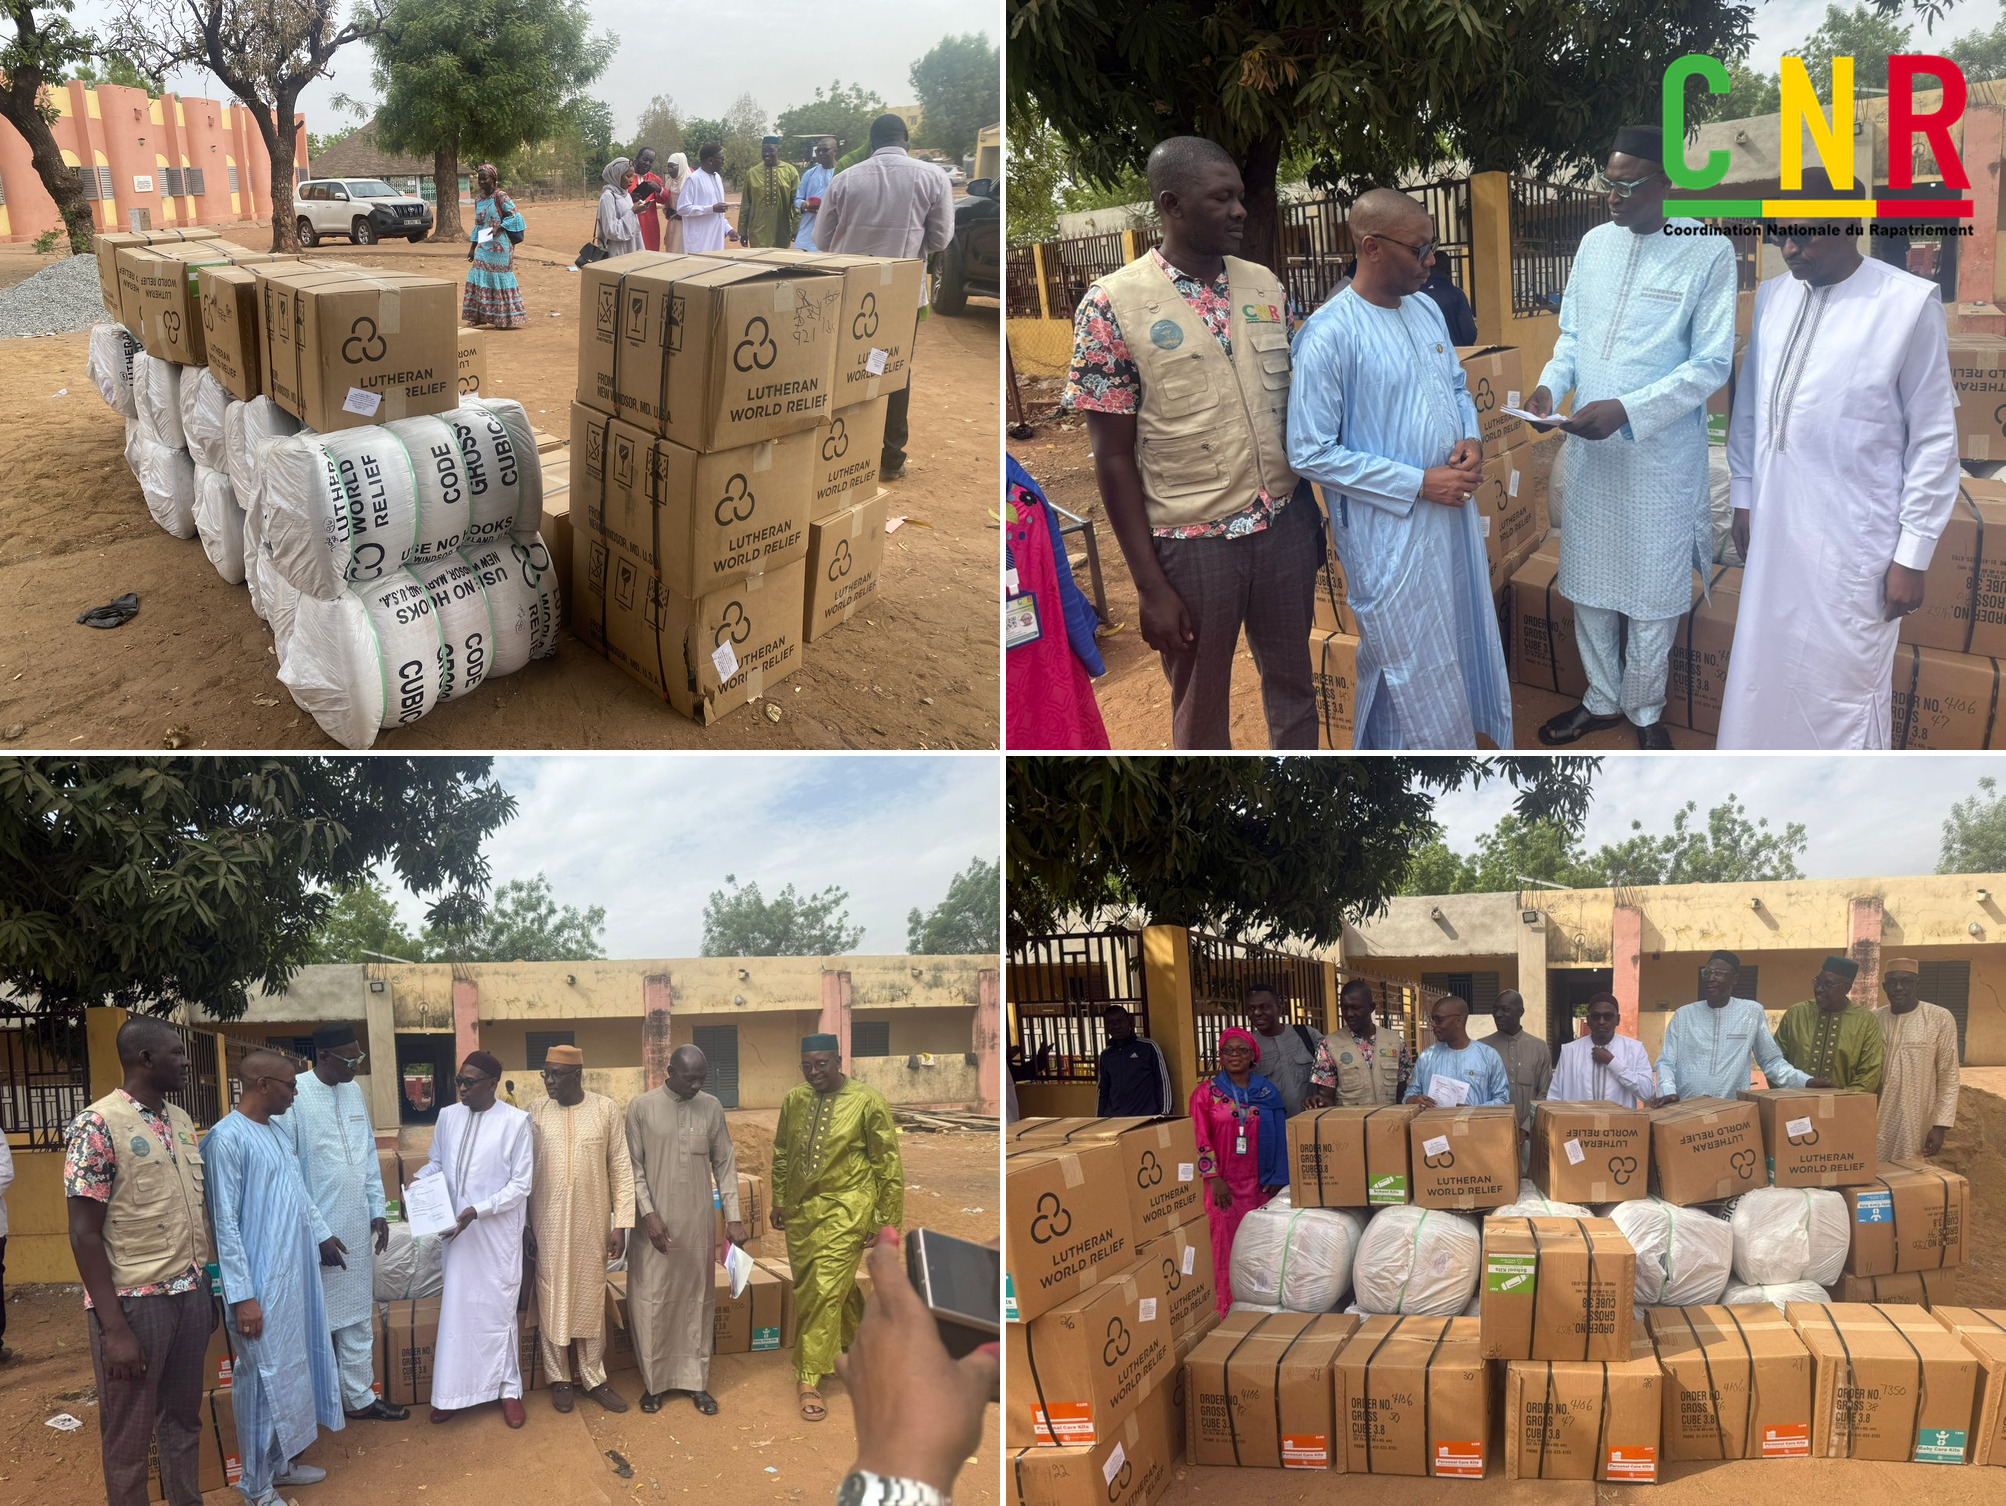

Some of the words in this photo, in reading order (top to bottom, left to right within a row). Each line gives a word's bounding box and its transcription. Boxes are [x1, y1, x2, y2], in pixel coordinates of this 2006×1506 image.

[145, 289, 172, 300] LUTHERAN
[1242, 304, 1280, 319] CNR
[360, 368, 433, 389] LUTHERAN
[747, 377, 819, 402] LUTHERAN
[640, 400, 653, 417] MD.
[730, 403, 782, 423] WORLD
[787, 393, 828, 414] RELIEF
[1503, 420, 1522, 435] RELIEF
[431, 442, 462, 504] CODE
[828, 459, 871, 483] LUTHERAN
[360, 454, 389, 528] RELIEF
[817, 480, 848, 500] WORLD
[849, 469, 876, 488] RELIEF
[339, 459, 367, 535] WORLD
[729, 519, 792, 552] LUTHERAN
[436, 535, 460, 553] NO
[713, 547, 761, 573] WORLD
[763, 530, 802, 556] RELIEF
[480, 551, 501, 569] NEW
[453, 579, 476, 600] NO
[834, 570, 873, 601] LUTHERAN
[824, 596, 852, 619] WORLD
[853, 579, 878, 601] RELIEF
[395, 589, 452, 625] HOOKS
[1951, 605, 1969, 620] NO.
[1523, 614, 1547, 629] ORDER
[1523, 626, 1547, 642] GROSS
[736, 635, 786, 670] UTHERAN
[1524, 638, 1542, 652] CUBE
[464, 632, 484, 689] CODE
[761, 643, 796, 673] RELIEF
[1704, 652, 1719, 667] NO.
[1335, 675, 1349, 689] NO.
[1696, 678, 1710, 692] 3.8
[1332, 701, 1344, 714] 3.8
[1923, 697, 1943, 714] NO.
[1931, 714, 1951, 730] 47
[1911, 725, 1929, 740] 3.8
[1566, 1129, 1600, 1137] RELIEF
[1602, 1129, 1639, 1137] WORLD
[1716, 1121, 1751, 1136] WORLD
[1680, 1129, 1715, 1145] RELIEF
[1692, 1134, 1744, 1153] LUTHERAN
[1799, 1152, 1854, 1163] LUTHERAN
[1789, 1164, 1828, 1174] WORLD
[1829, 1162, 1866, 1173] RELIEF
[1437, 1175, 1492, 1186] LUTHERAN
[1149, 1183, 1189, 1207] LUTHERAN
[1427, 1188, 1465, 1196] WORLD
[1468, 1185, 1503, 1195] RELIEF
[1142, 1204, 1172, 1224] WORLD
[1174, 1192, 1197, 1211] RELIEF
[1052, 1228, 1113, 1267] LUTHERAN
[1039, 1259, 1086, 1289] WORLD
[1089, 1238, 1125, 1265] RELIEF
[1169, 1282, 1205, 1314] LUTHERAN
[1595, 1297, 1616, 1309] CUBE
[1169, 1307, 1189, 1326] ORLD
[1190, 1289, 1211, 1314] RELIEF
[1588, 1310, 1615, 1321] GROSS
[1588, 1323, 1615, 1334] ORDER
[1118, 1338, 1159, 1385] LUTHERAN
[1109, 1373, 1141, 1408] WORLD
[1143, 1345, 1167, 1377] RELIEF
[1463, 1371, 1474, 1381] 30
[1680, 1390, 1707, 1402] ORDER
[1867, 1388, 1882, 1400] NO.
[1881, 1383, 1907, 1396] 7350
[1200, 1393, 1225, 1406] ORDER
[1379, 1398, 1393, 1410] NO.
[1200, 1405, 1226, 1417] GROSS
[1555, 1403, 1570, 1415] NO.
[1681, 1402, 1707, 1413] GROSS
[1201, 1417, 1220, 1429] CUBE
[1561, 1415, 1576, 1427] 47
[1681, 1414, 1702, 1425] CUBE
[1703, 1414, 1715, 1424] 3.8
[1858, 1413, 1871, 1423] 3.8
[1373, 1424, 1385, 1435] 3.8
[1548, 1429, 1560, 1440] 3.8
